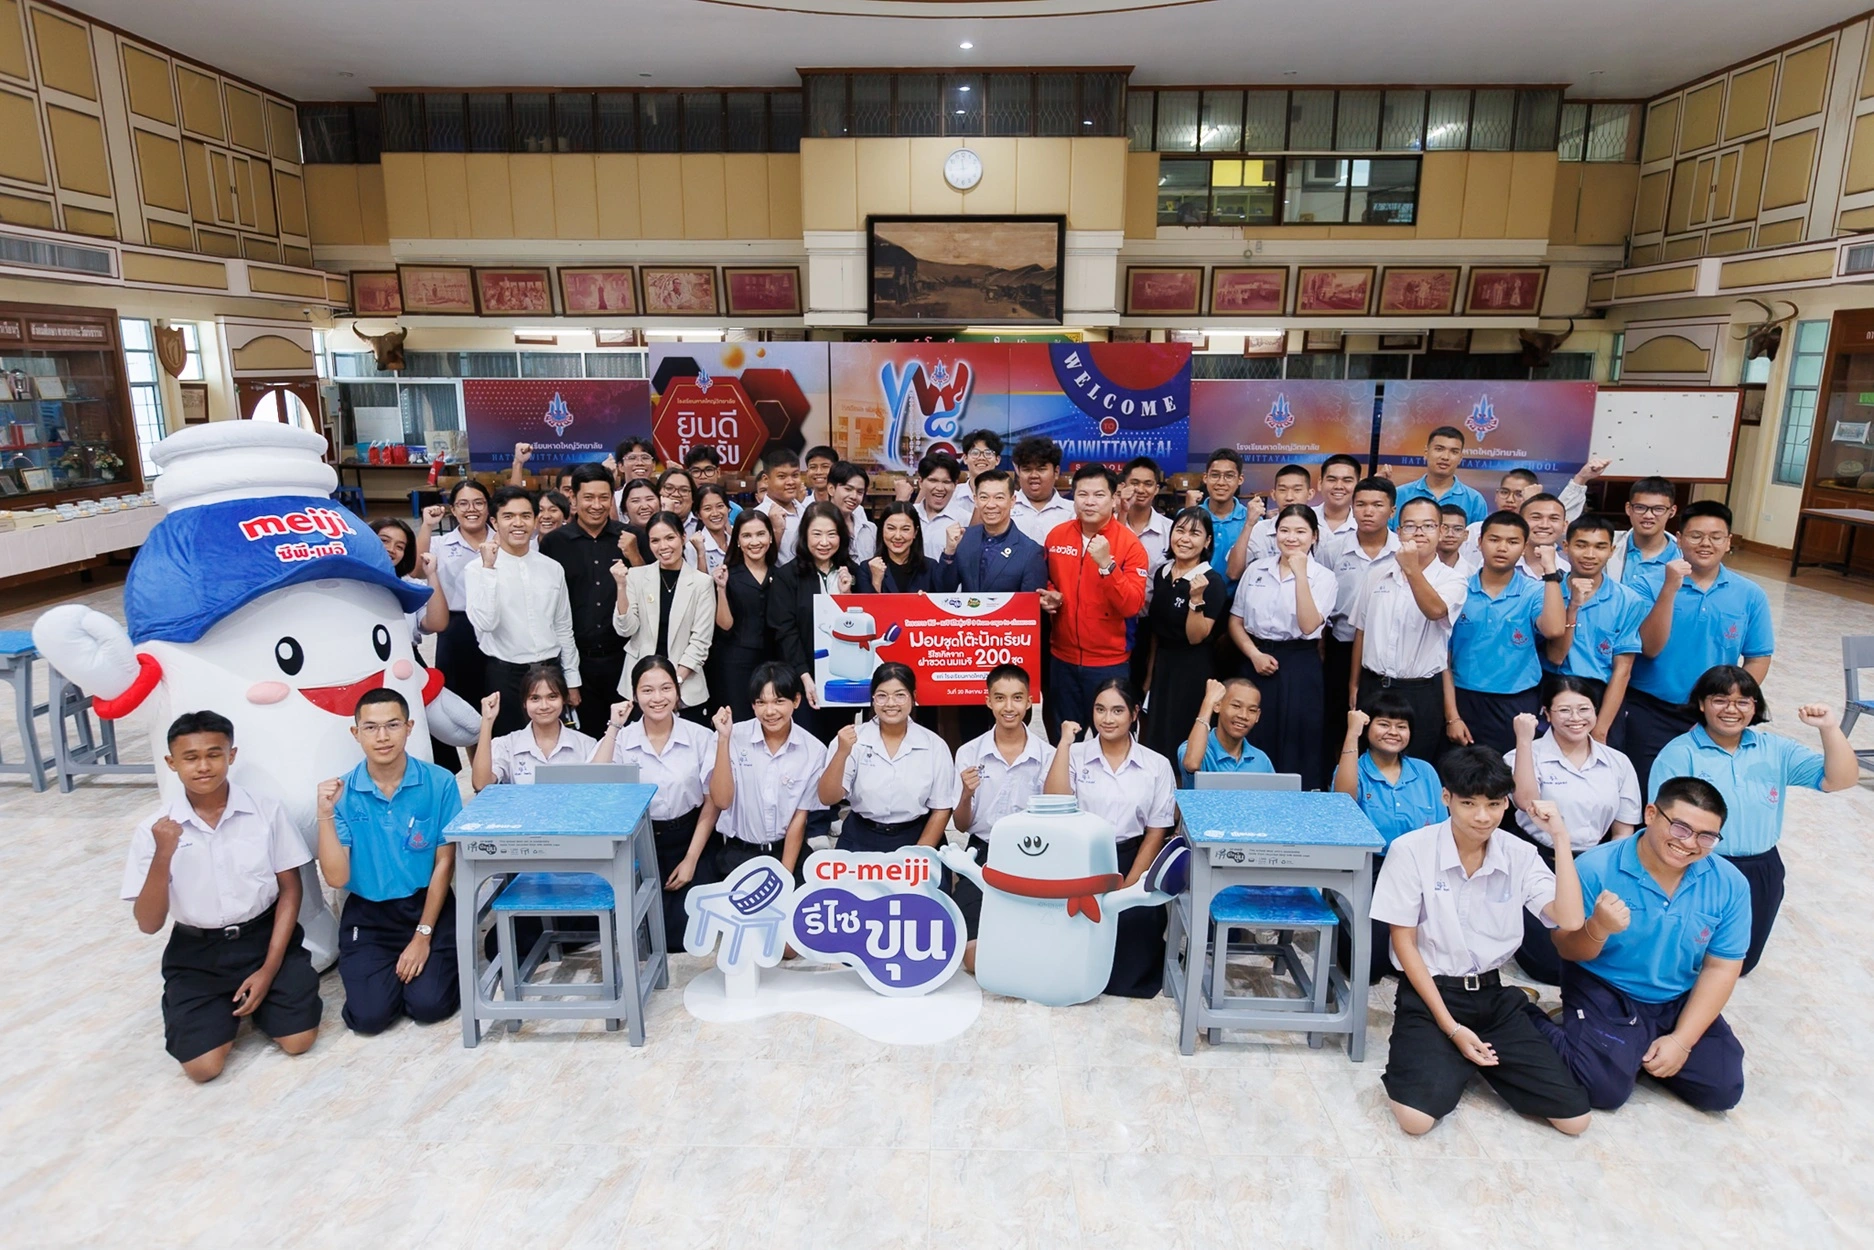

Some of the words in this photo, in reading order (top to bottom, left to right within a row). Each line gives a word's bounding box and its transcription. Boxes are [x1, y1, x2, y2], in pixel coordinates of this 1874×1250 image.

[1064, 351, 1176, 417] WELCOME
[677, 409, 738, 438] ยินดี
[1103, 423, 1115, 431] TO
[531, 441, 603, 450] เรียนหาดใหญ่วิทยาลัย
[678, 438, 740, 465] ต้รับ
[1052, 440, 1171, 458] YAIWITTAYALAI
[1462, 447, 1527, 458] หาดใหญ่วิทยาลัย
[241, 508, 351, 539] meiji
[909, 630, 1032, 650] มอบชุดโต๊ะนักเรียน
[975, 648, 1011, 665] 200
[815, 858, 929, 887] CP-meiji
